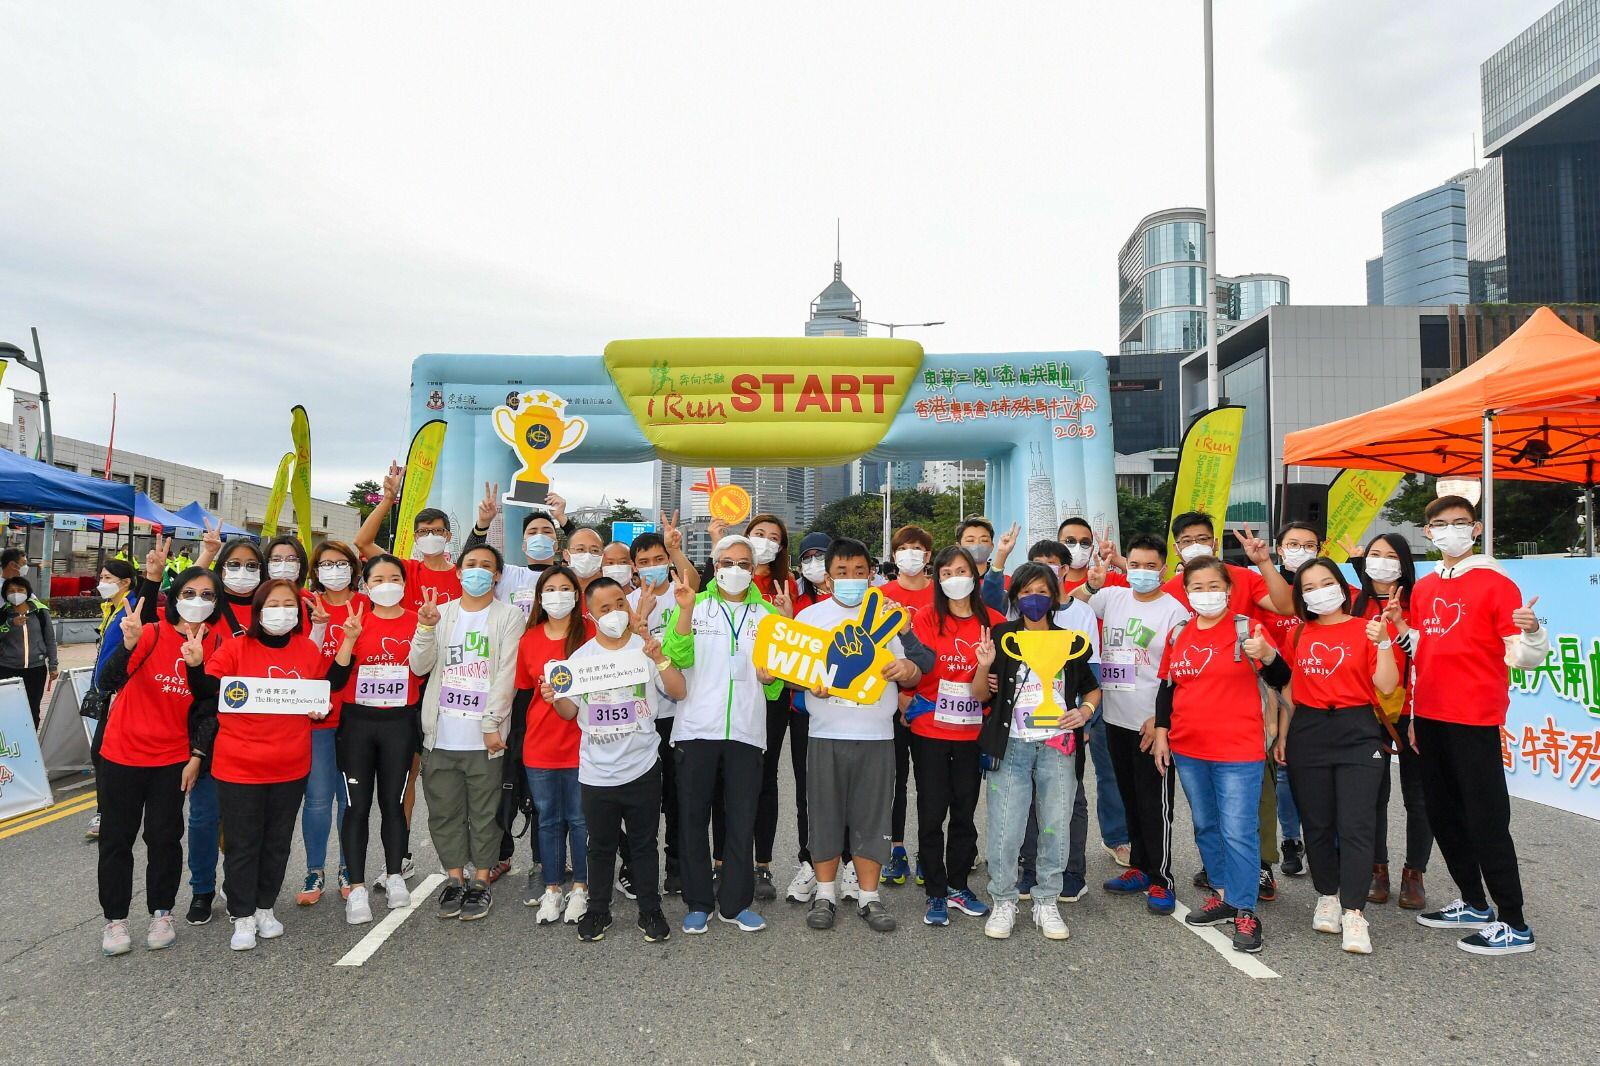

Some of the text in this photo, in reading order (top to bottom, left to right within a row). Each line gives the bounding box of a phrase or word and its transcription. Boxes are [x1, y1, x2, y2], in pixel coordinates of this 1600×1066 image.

[731, 374, 894, 413] START
[664, 392, 727, 420] Run
[1054, 423, 1096, 438] 2023
[772, 621, 824, 654] Sure
[367, 653, 395, 663] CARE
[940, 654, 967, 663] CARE
[1298, 658, 1322, 667] CARE
[766, 643, 839, 689] WIN
[154, 673, 186, 685] CARE
[1102, 668, 1126, 679] 3151
[360, 683, 405, 695] 3154P
[446, 692, 480, 707] 3154
[939, 698, 980, 713] 3160P
[596, 707, 629, 721] 3153
